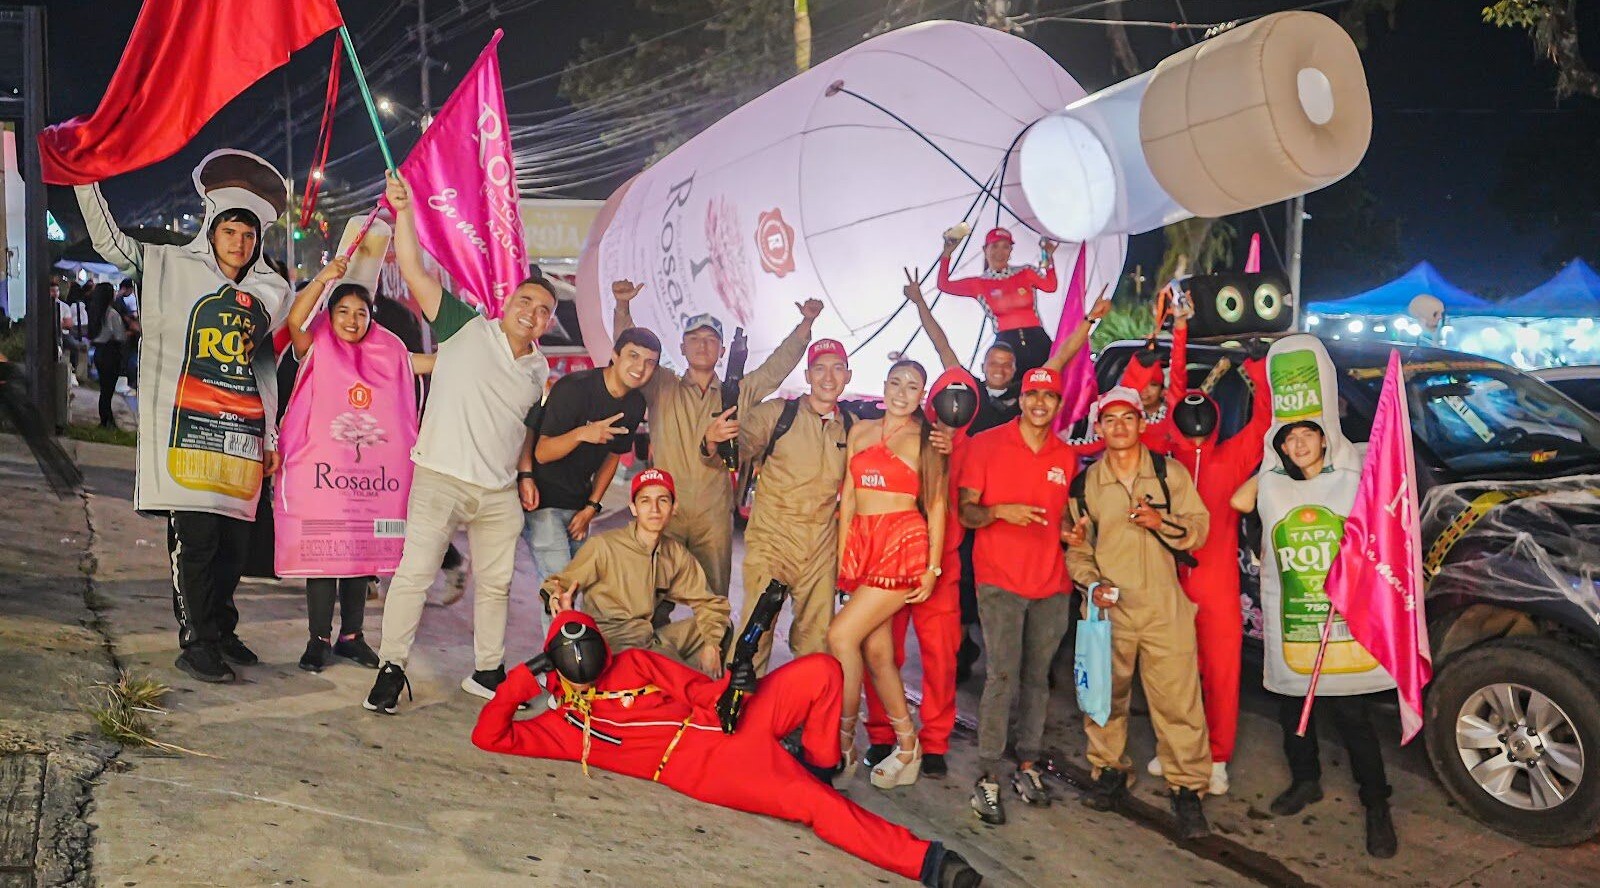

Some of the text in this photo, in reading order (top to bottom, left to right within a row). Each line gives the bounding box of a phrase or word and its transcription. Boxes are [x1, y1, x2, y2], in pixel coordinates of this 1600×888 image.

[1273, 389, 1321, 412] ROJA
[313, 462, 400, 492] Rosado
[1290, 529, 1338, 543] TAPA
